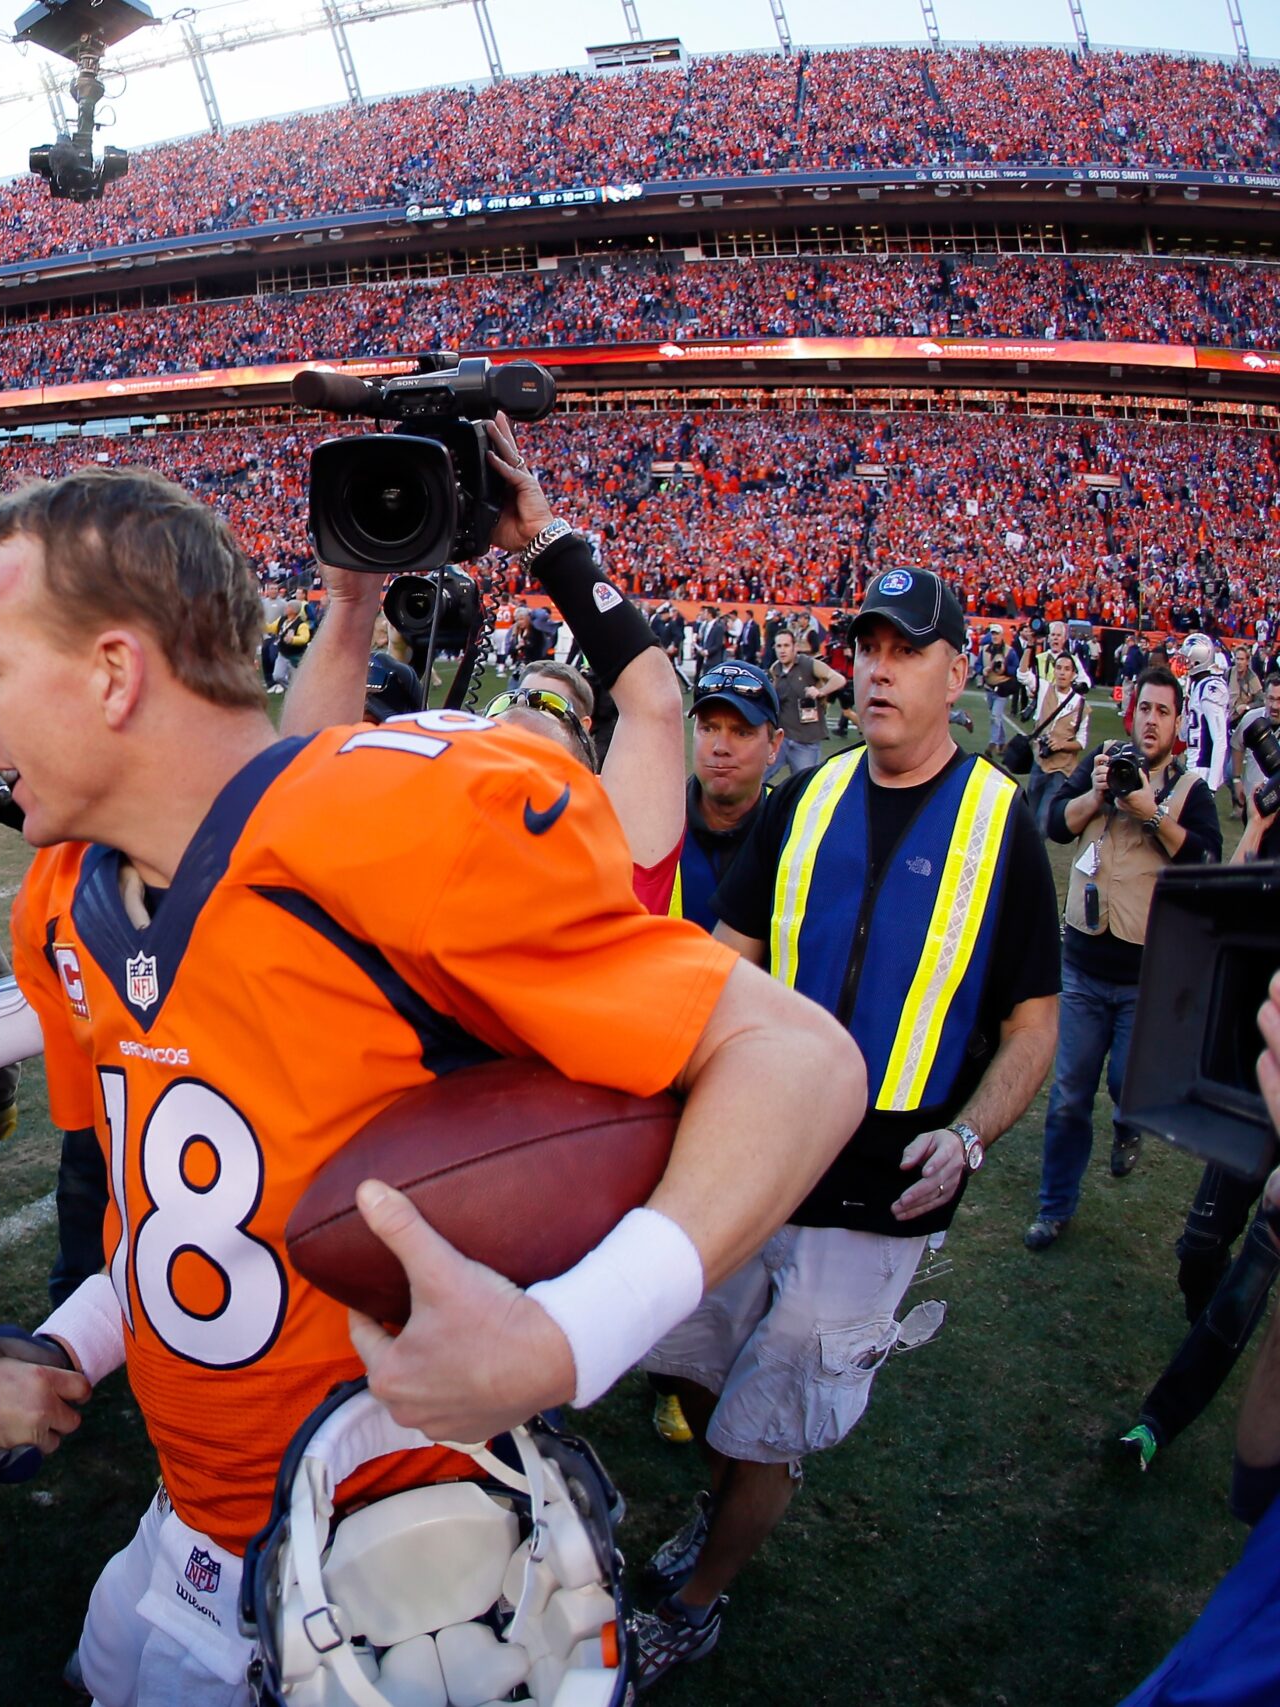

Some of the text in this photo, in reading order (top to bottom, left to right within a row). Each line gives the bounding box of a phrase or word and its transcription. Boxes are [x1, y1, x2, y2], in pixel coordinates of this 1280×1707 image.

[943, 170, 965, 180] TOM
[966, 169, 998, 179] NALEN
[1088, 169, 1099, 179] 80
[1100, 169, 1120, 179] ROD
[1121, 170, 1150, 180] SMITH
[1228, 174, 1280, 187] 84 SHANNO
[422, 206, 444, 216] BUICK
[465, 200, 482, 212] 16
[487, 198, 507, 209] 4TH
[539, 194, 556, 205] 1ST
[685, 346, 730, 358] UNITED
[943, 345, 989, 357] UNITED
[1004, 346, 1057, 359] ORANGE
[337, 362, 377, 375] UNITED
[392, 360, 419, 373] ORA
[126, 381, 161, 391] UNITED
[55, 948, 84, 1001] C
[132, 976, 156, 1000] NFL
[119, 1040, 190, 1066] BRONCOS
[96, 1063, 289, 1370] 18
[187, 1560, 216, 1591] NFL
[175, 1580, 222, 1627] Wilson
